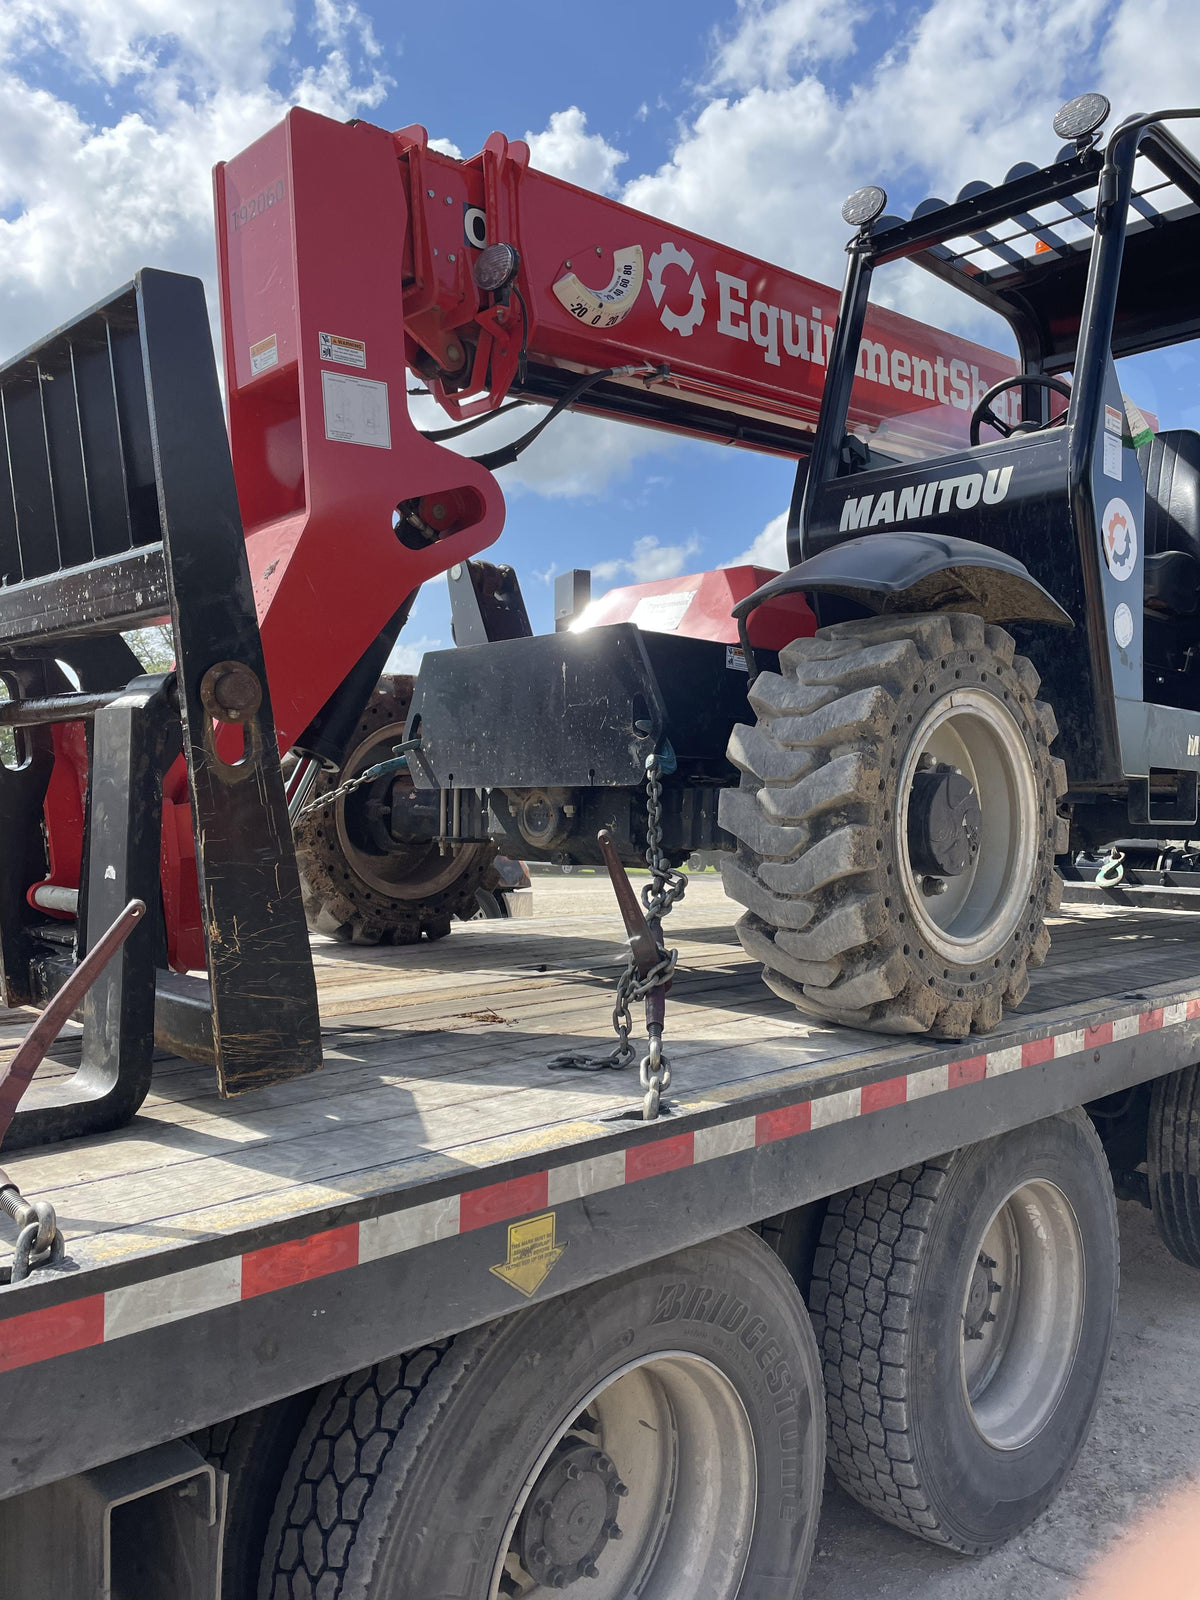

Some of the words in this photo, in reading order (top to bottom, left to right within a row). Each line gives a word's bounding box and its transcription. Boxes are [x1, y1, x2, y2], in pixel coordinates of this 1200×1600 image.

[623, 264, 633, 276] 80
[619, 278, 630, 288] 60
[570, 303, 588, 318] -20
[591, 314, 601, 325] 0
[715, 270, 1022, 427] EquimentShar
[839, 465, 1014, 532] MANITOU
